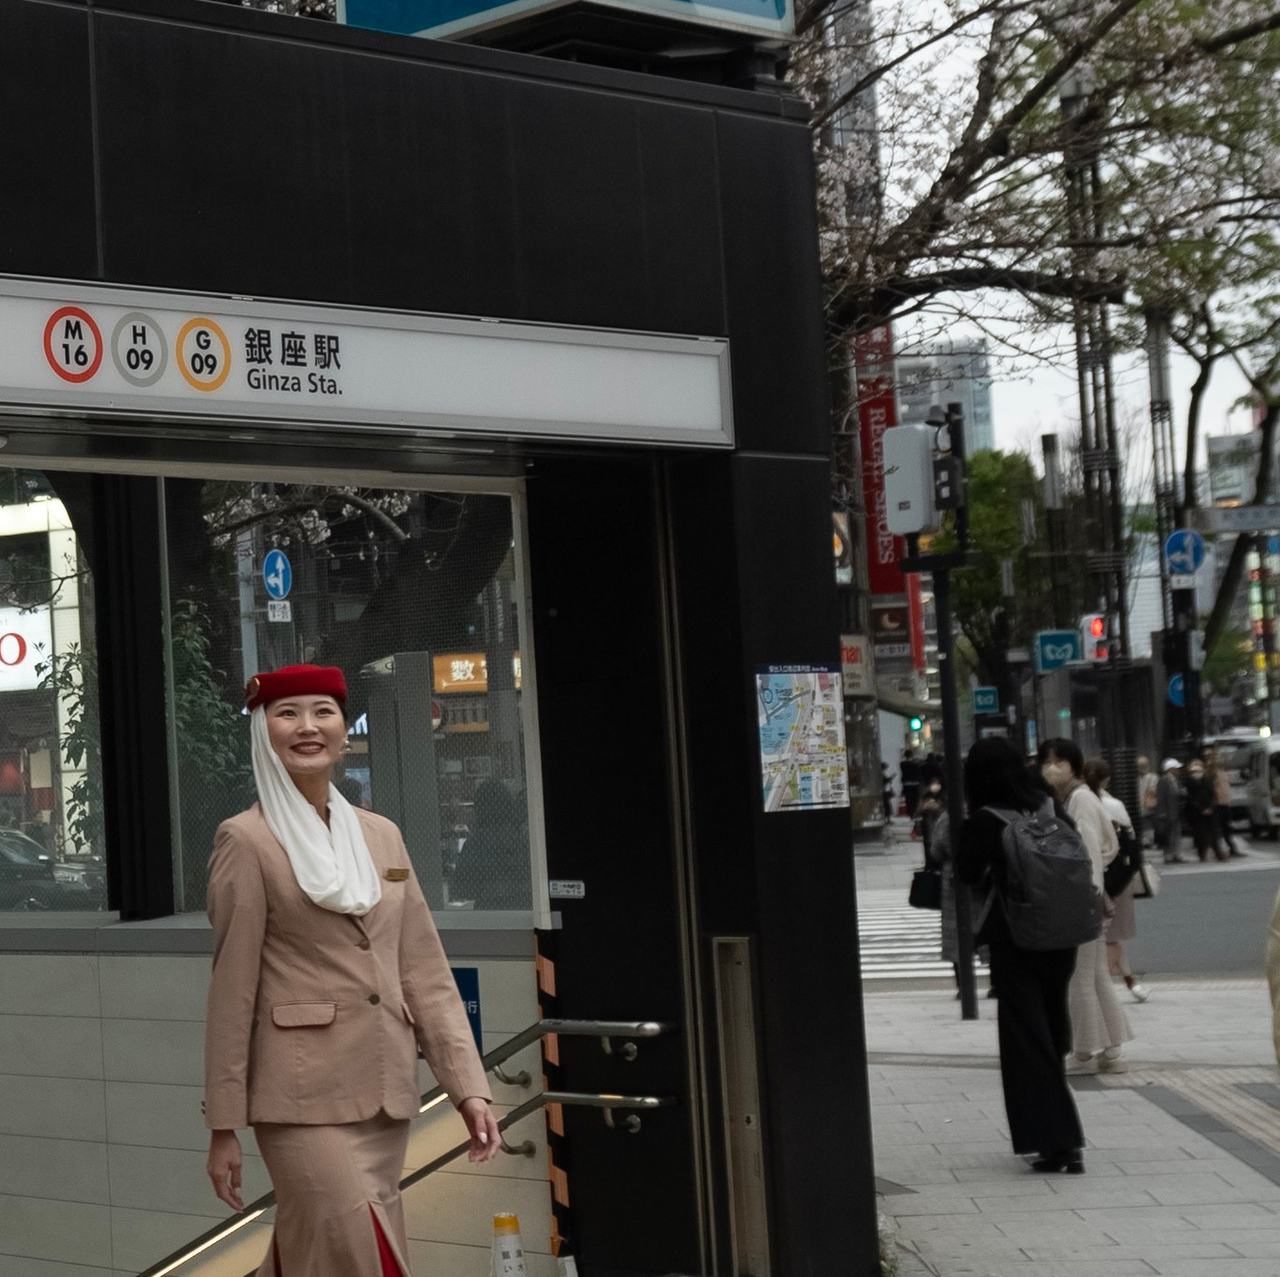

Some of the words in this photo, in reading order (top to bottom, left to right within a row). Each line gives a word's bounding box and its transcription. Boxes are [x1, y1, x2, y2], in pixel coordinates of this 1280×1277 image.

[63, 319, 83, 340] M
[132, 325, 147, 345] H
[196, 330, 212, 350] G
[61, 343, 88, 367] 16
[126, 348, 154, 371] 09
[244, 327, 341, 370] 銀座駅
[190, 353, 217, 376] 09
[246, 368, 302, 393] Ginza
[308, 373, 343, 396] Sta.
